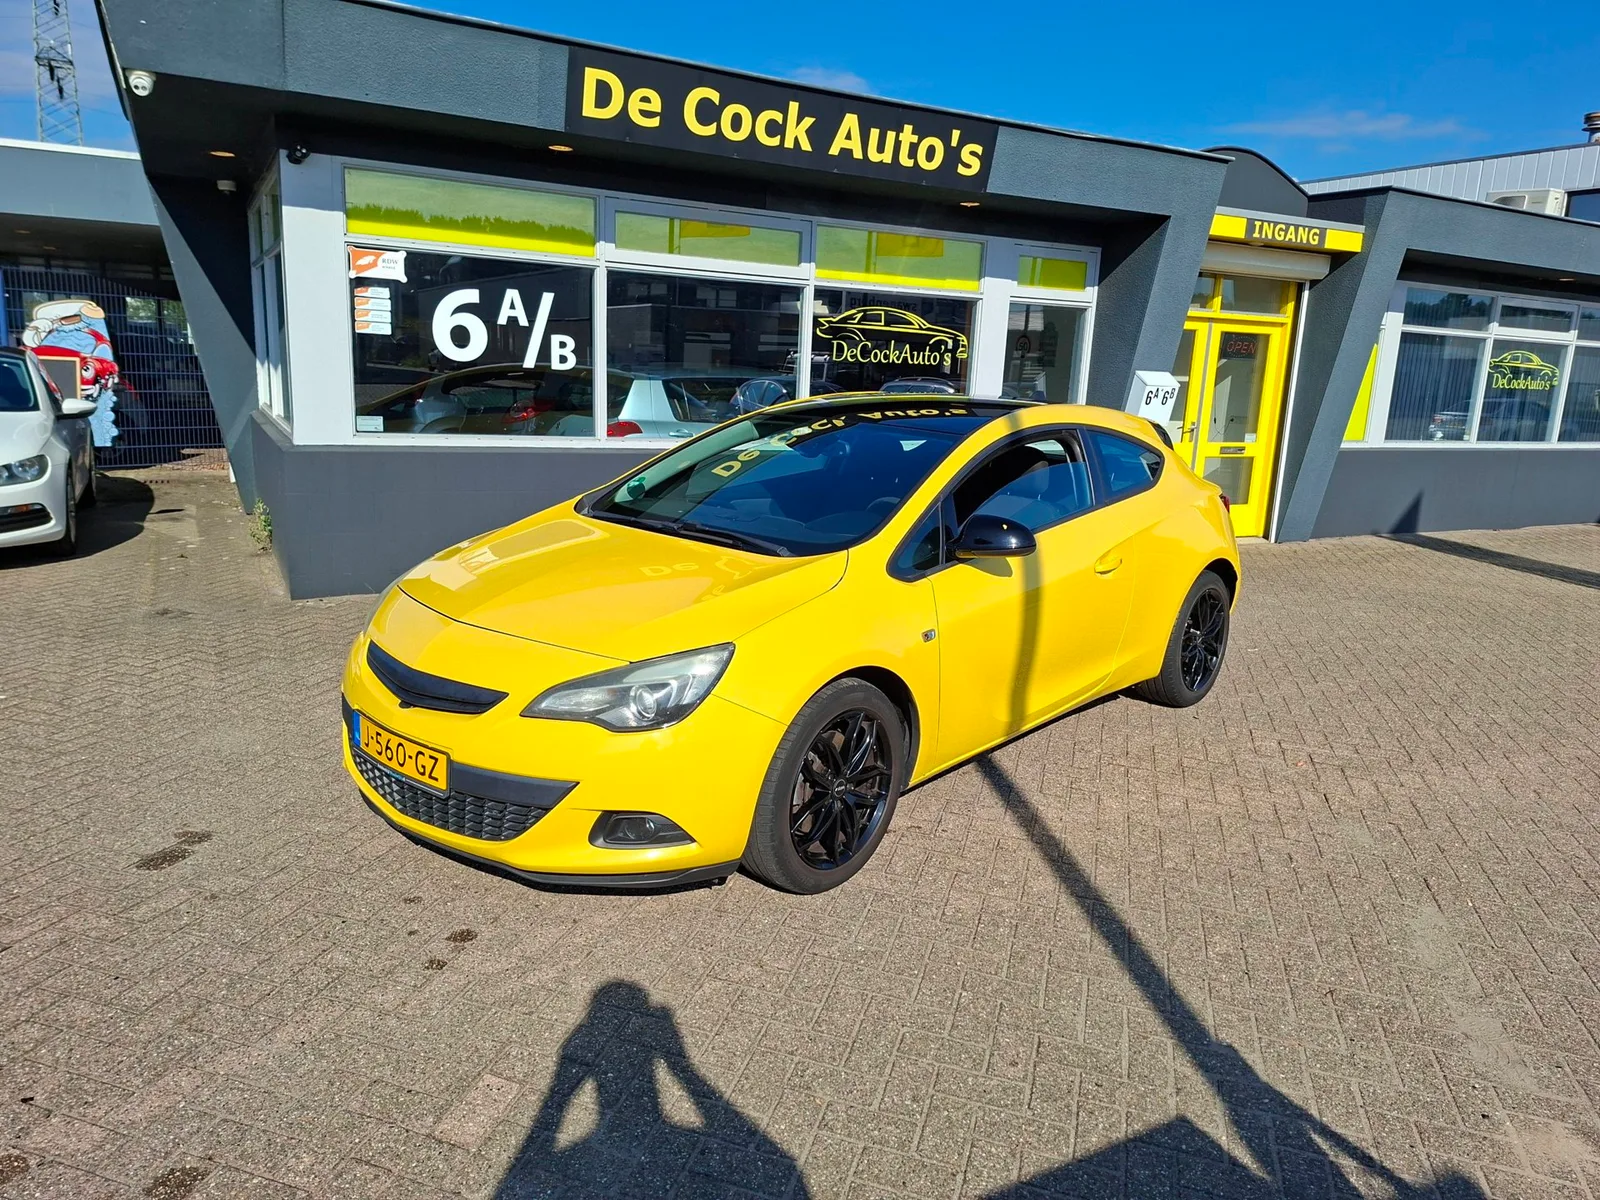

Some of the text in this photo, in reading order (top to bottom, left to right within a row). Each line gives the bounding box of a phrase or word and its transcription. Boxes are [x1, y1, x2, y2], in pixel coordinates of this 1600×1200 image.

[582, 67, 983, 176] De Cock Auto's
[1252, 221, 1320, 245] INGANG
[1226, 341, 1256, 354] OPEN
[364, 726, 440, 782] J-560-GZ
